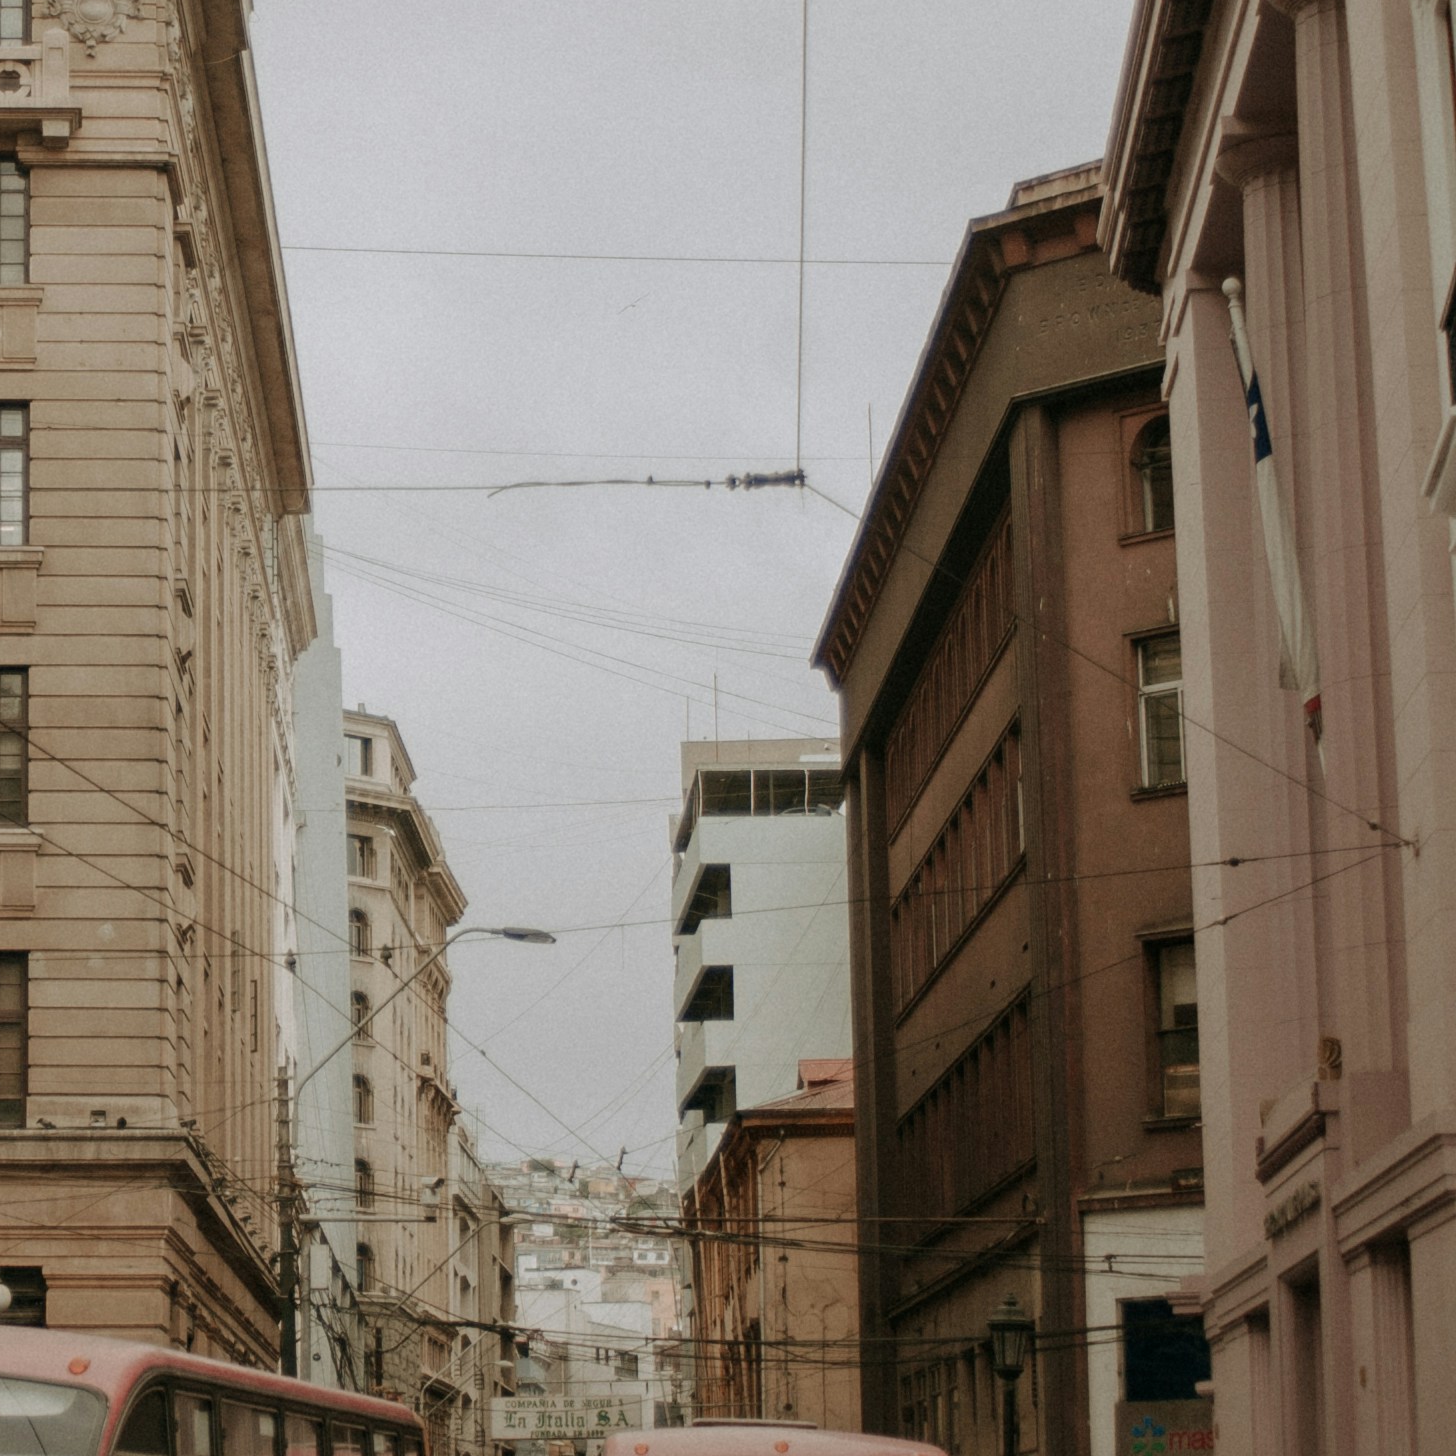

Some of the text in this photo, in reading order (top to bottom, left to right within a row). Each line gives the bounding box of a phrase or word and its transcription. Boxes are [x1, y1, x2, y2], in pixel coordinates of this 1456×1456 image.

[563, 1399, 576, 1409] DE
[504, 1409, 635, 1428] La Italia S.A.
